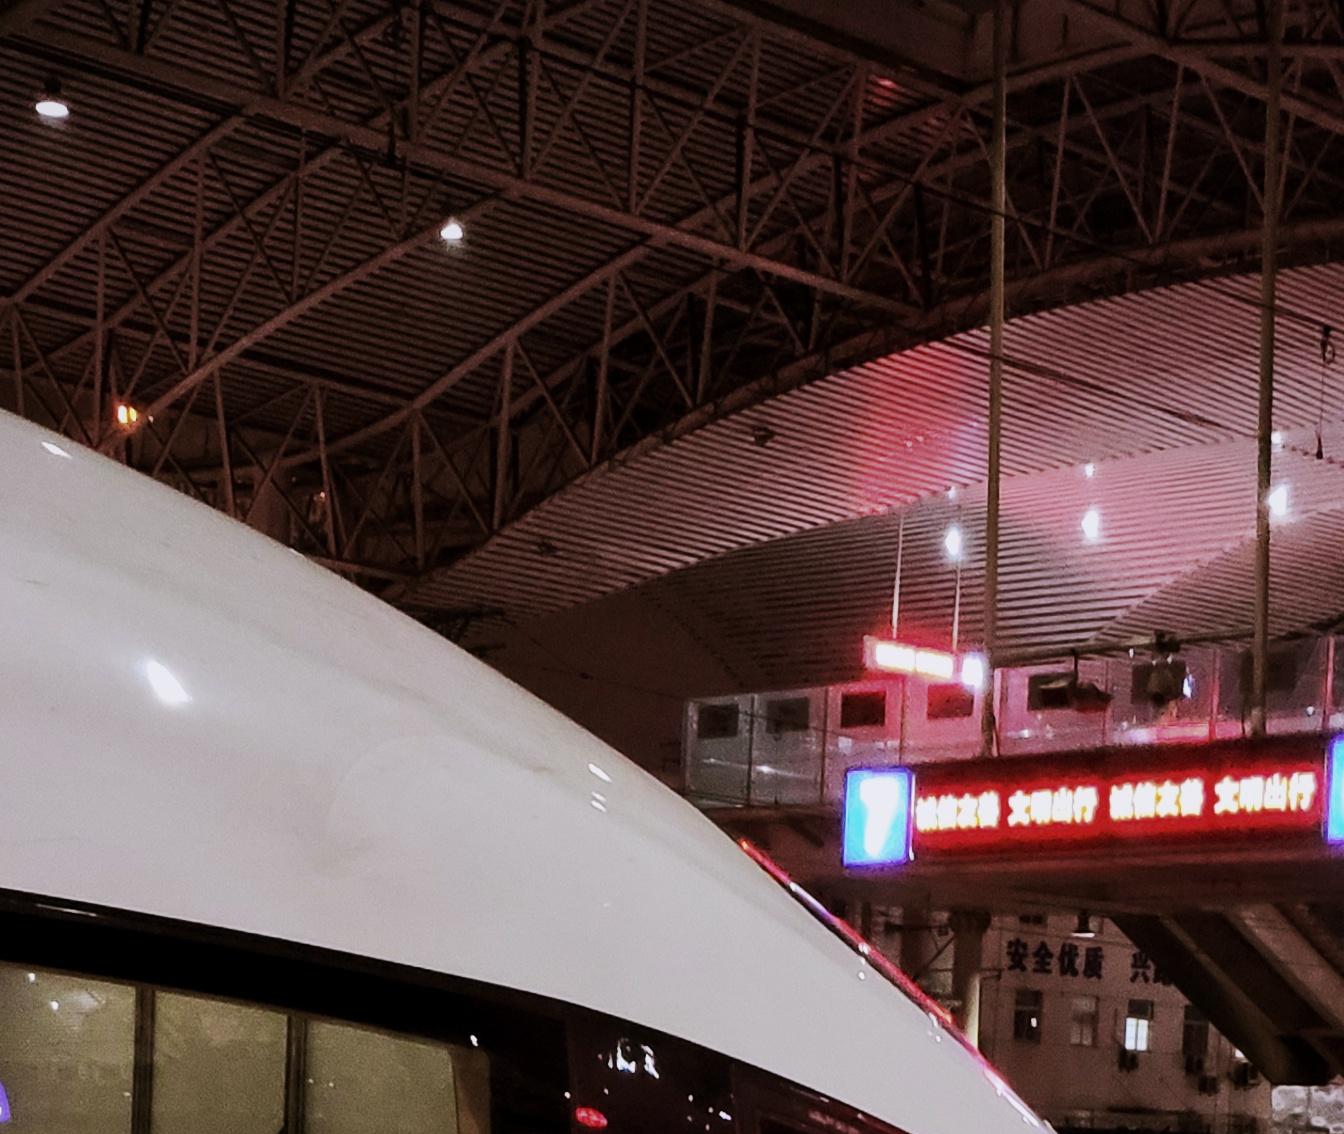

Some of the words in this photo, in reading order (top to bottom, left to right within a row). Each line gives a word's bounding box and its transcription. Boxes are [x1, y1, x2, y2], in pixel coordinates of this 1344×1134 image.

[859, 776, 899, 858] 7
[1008, 785, 1098, 828] 文明出行
[1213, 772, 1316, 815] 文明出行
[1006, 938, 1104, 979] 安全优质
